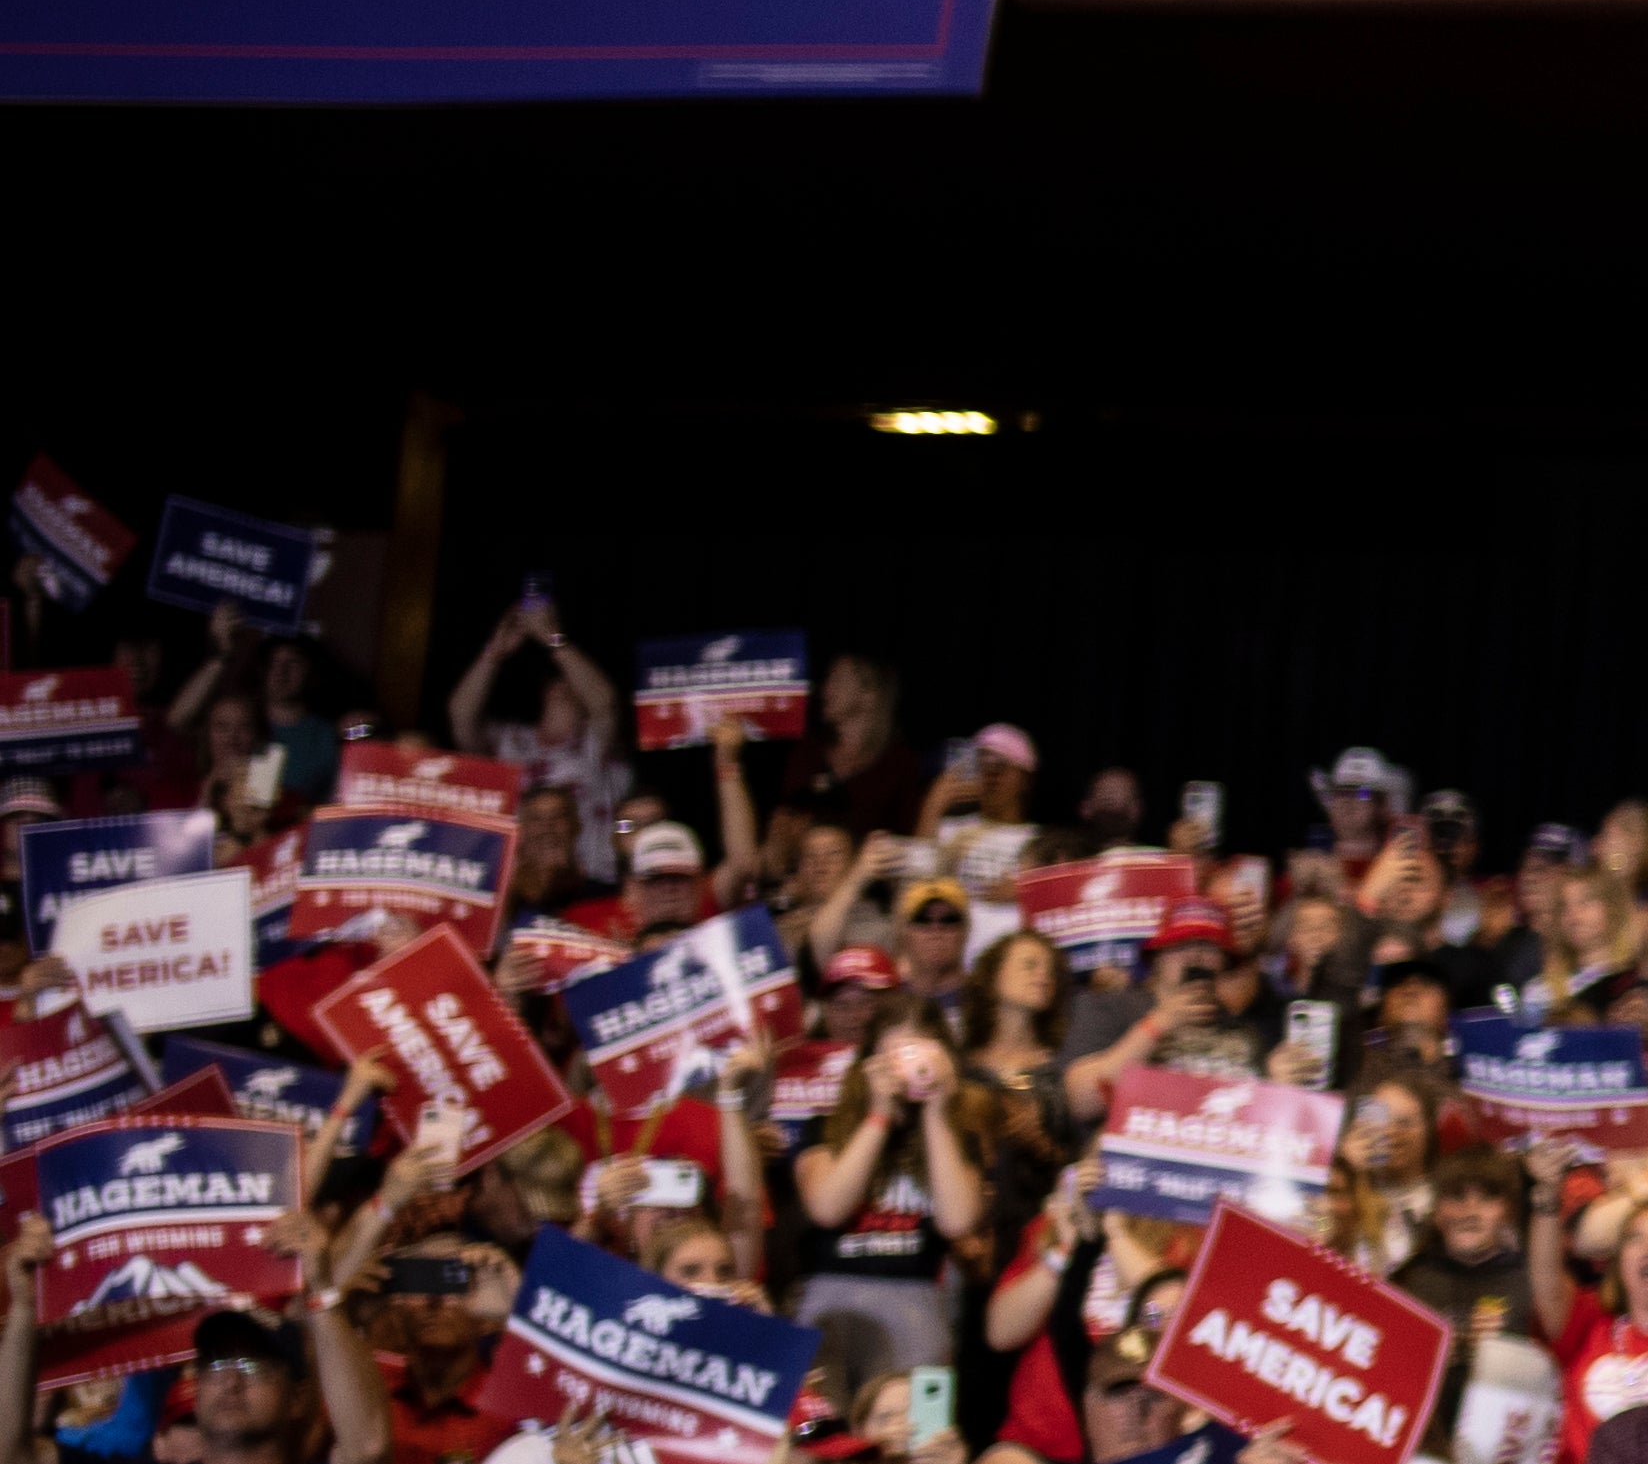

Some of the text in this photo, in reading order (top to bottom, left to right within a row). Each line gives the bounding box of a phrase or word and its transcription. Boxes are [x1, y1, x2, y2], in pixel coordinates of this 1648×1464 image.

[68, 846, 156, 884] SAVE
[101, 913, 190, 952] SAVE
[425, 991, 508, 1092] SAVE
[53, 1171, 276, 1229] HAGEMAN
[529, 1285, 778, 1409] HAGEMAN
[1263, 1277, 1382, 1370] SAVE
[1187, 1308, 1408, 1448] AMERICA!
